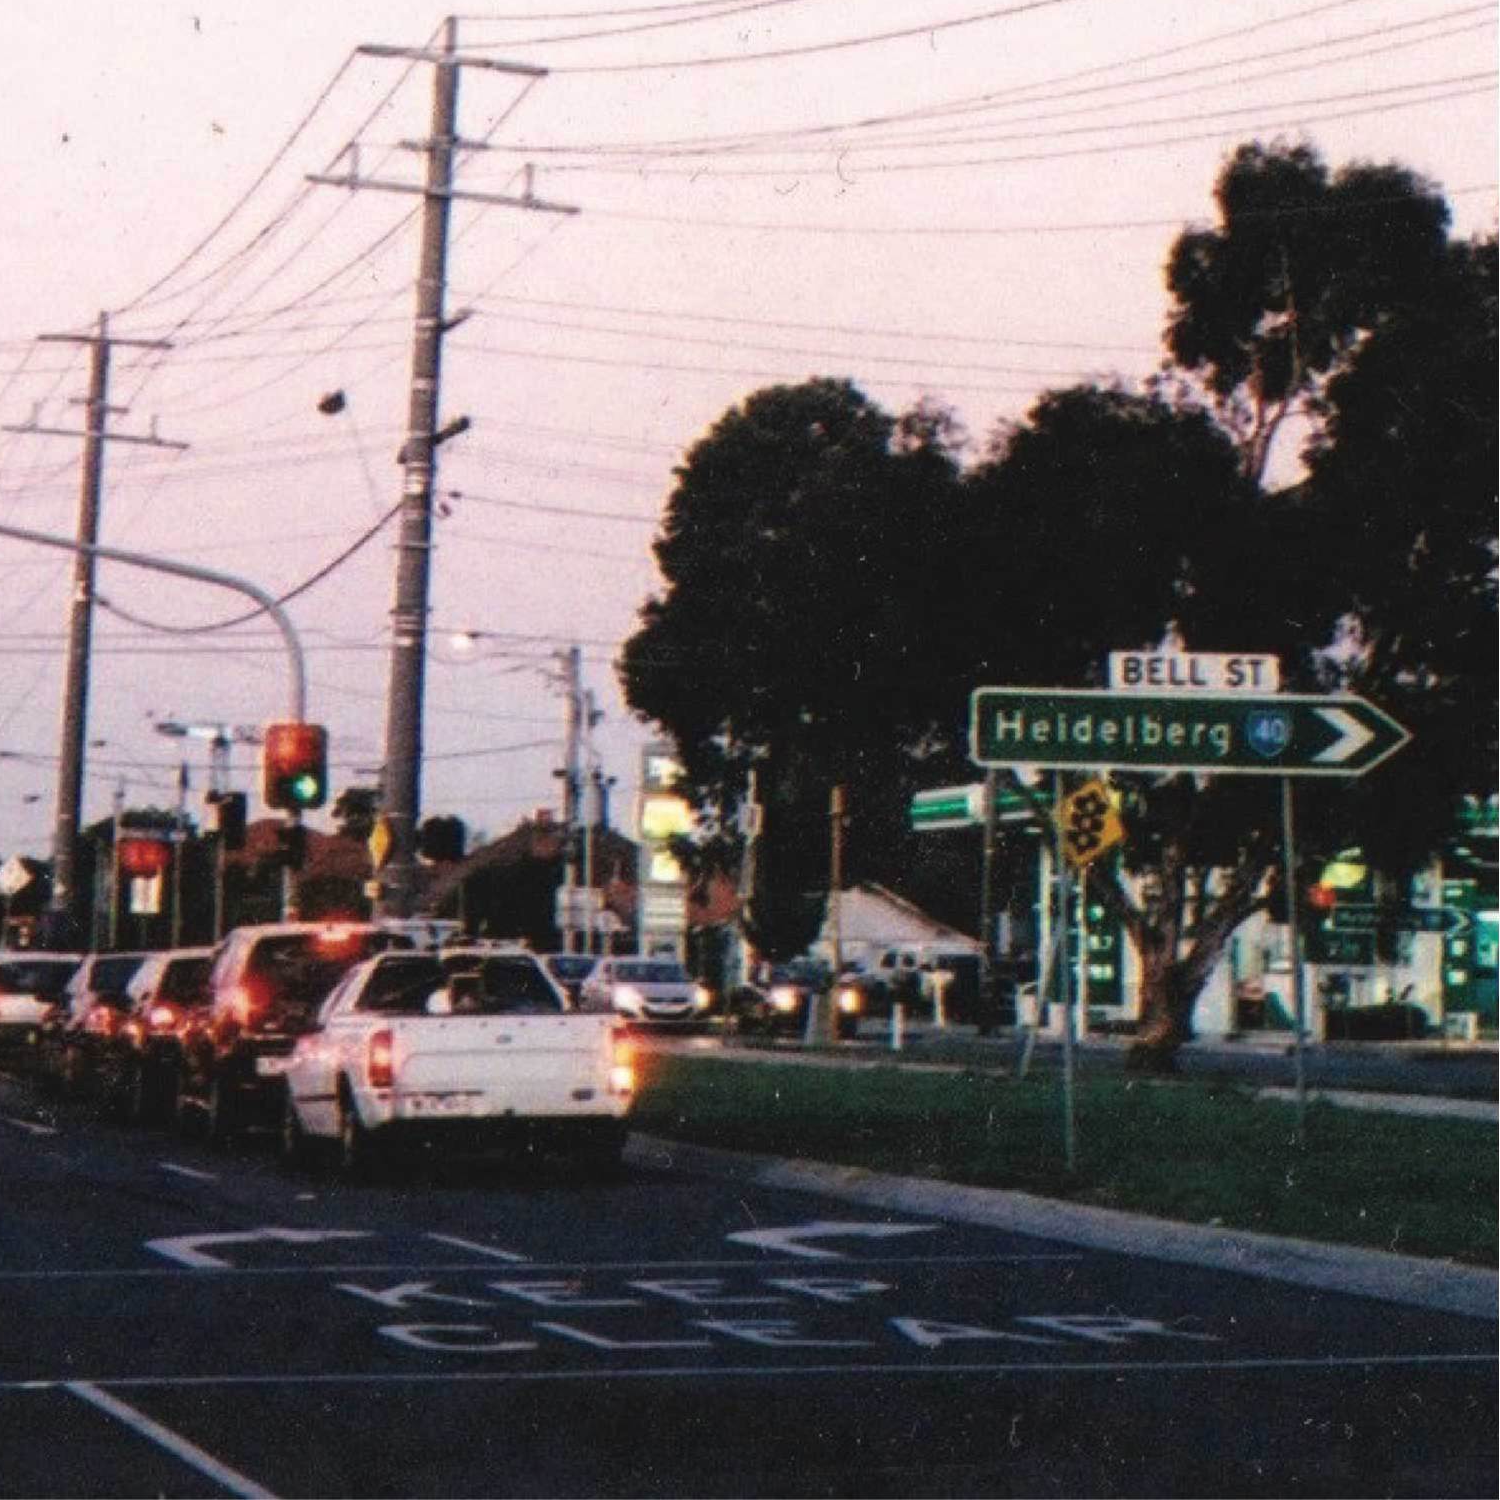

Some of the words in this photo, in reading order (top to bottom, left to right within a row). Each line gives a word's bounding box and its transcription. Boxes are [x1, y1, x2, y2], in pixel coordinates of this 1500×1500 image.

[1121, 656, 1208, 687] BELL
[1225, 659, 1266, 687] ST
[995, 708, 1232, 757] Heidelberg
[334, 1278, 892, 1308] KEEP
[375, 1314, 1224, 1350] CLEAR
